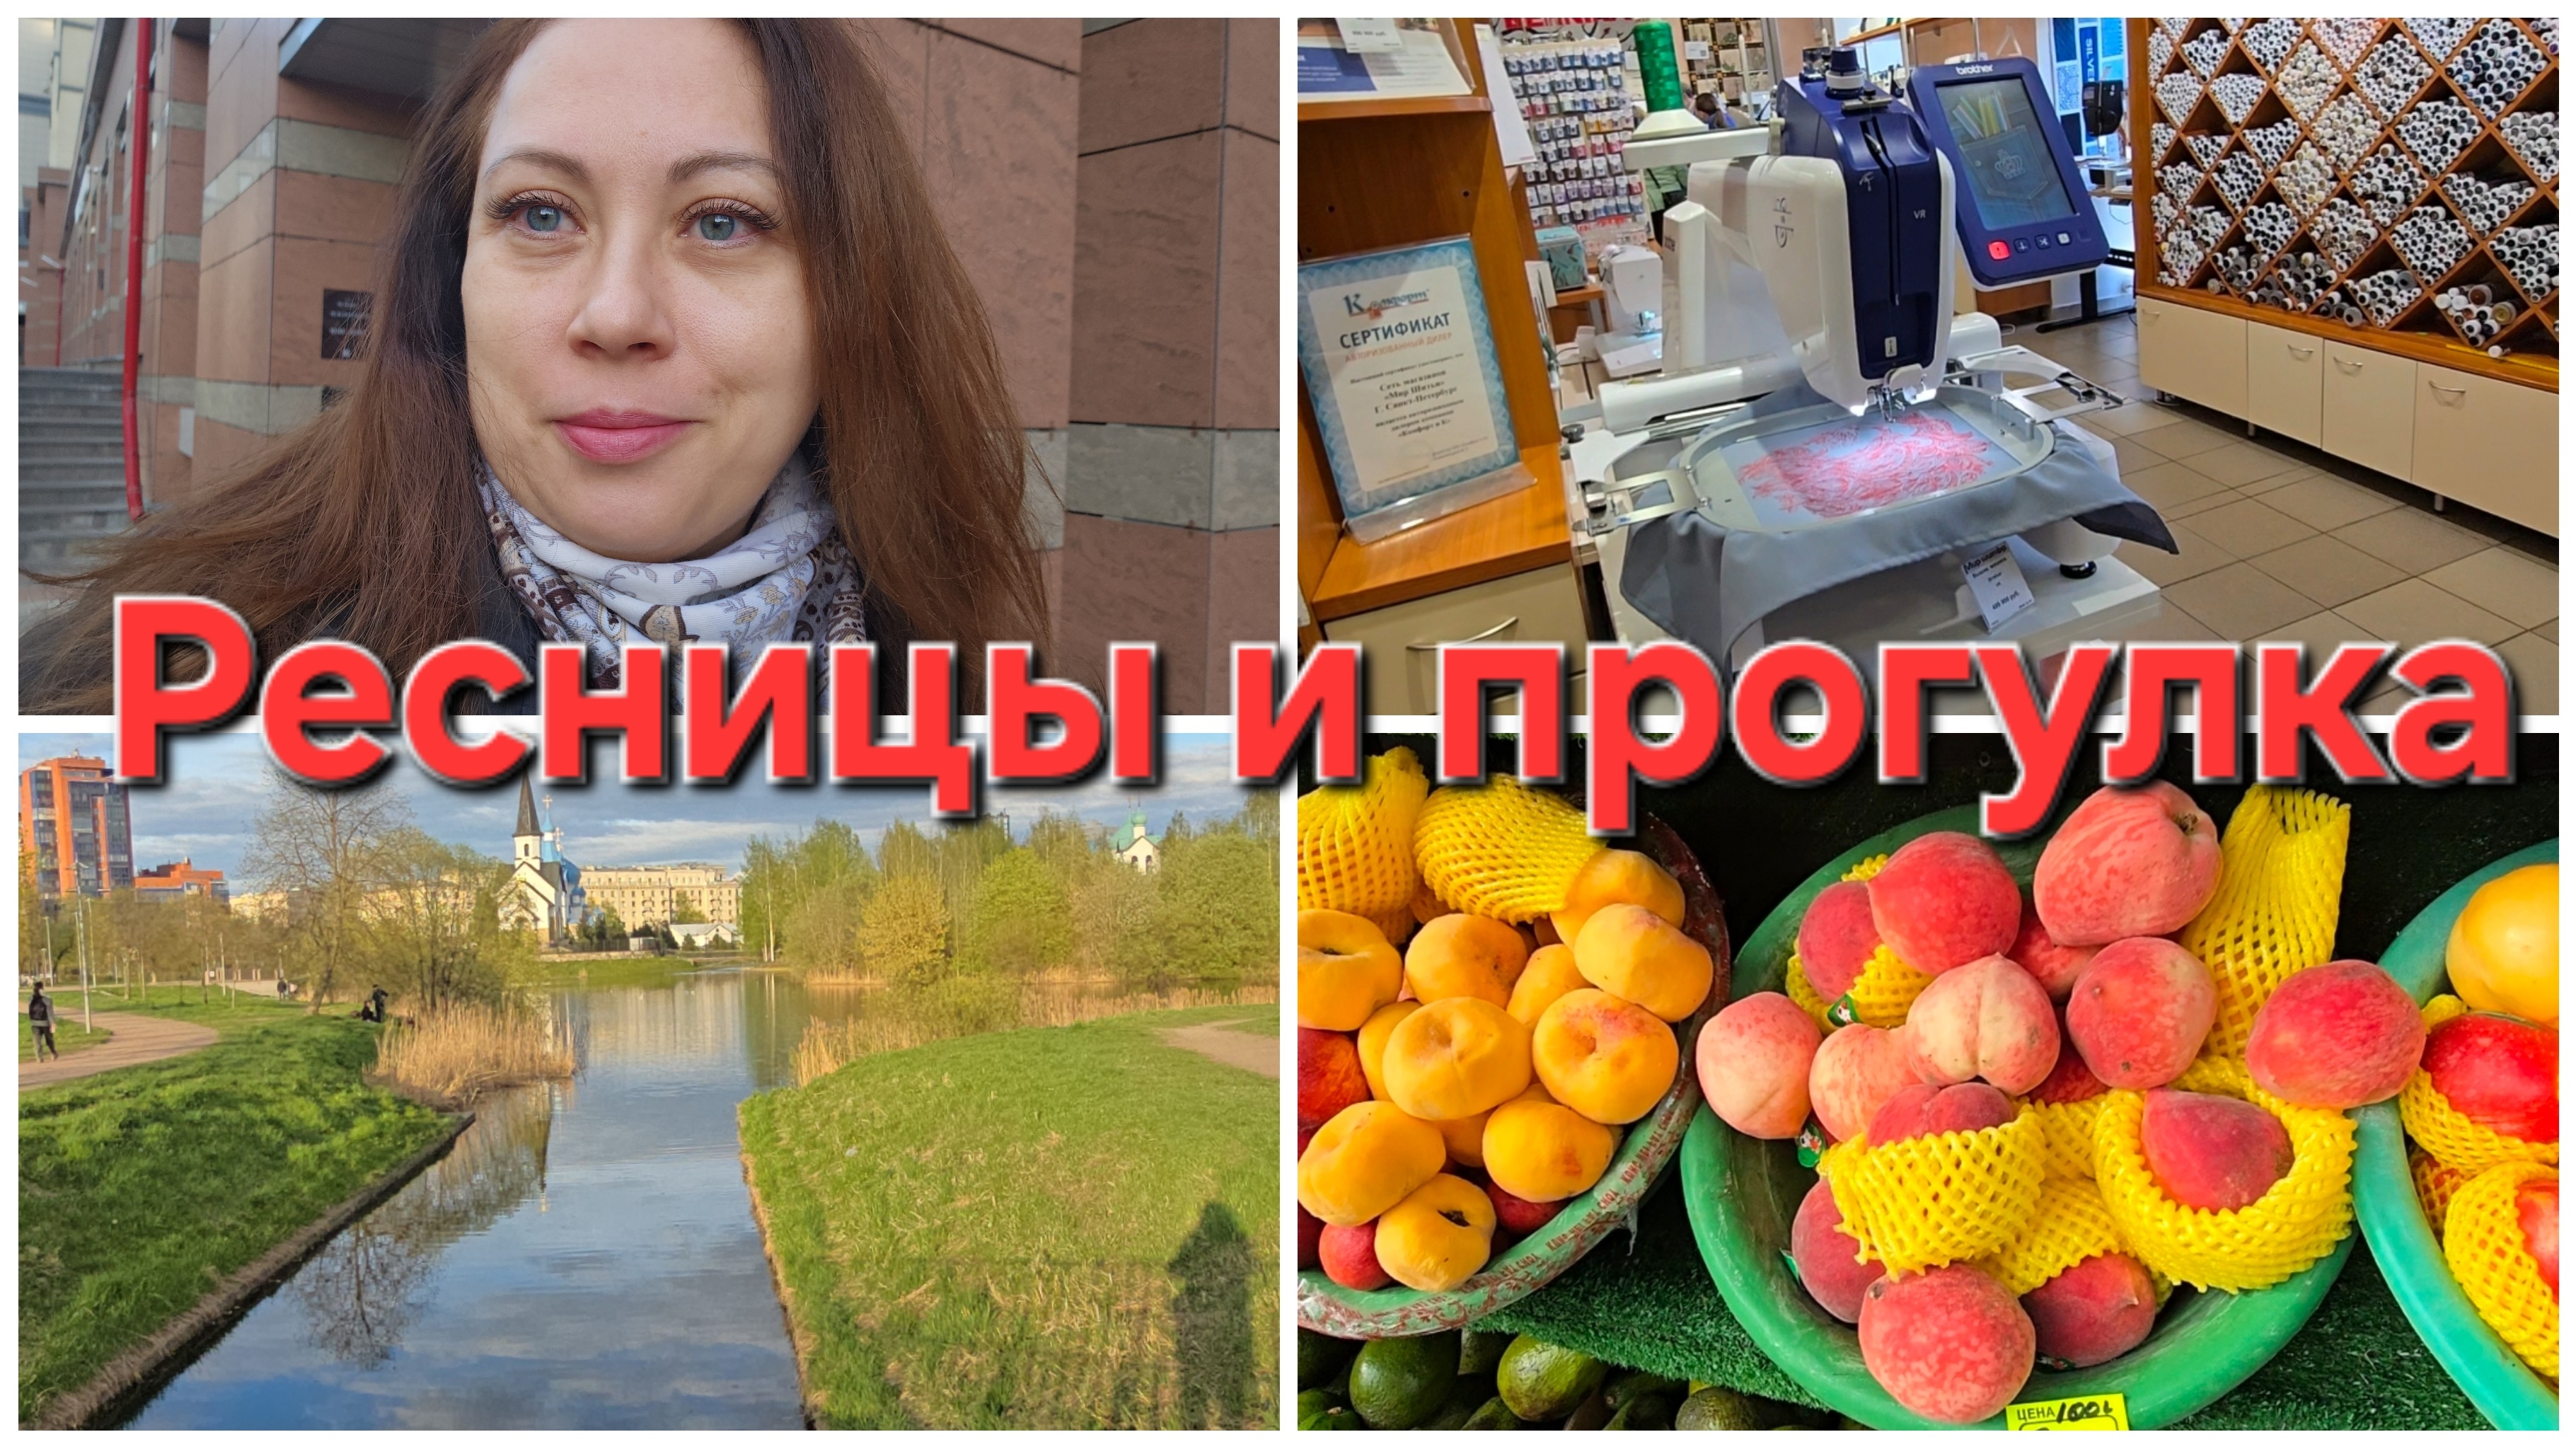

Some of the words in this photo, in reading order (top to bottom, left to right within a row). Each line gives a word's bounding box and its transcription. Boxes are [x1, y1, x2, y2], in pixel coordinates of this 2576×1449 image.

[1956, 64, 1993, 75] brother
[2085, 37, 2096, 82] SILVE
[1914, 209, 1926, 219] VR
[1339, 312, 1450, 349] СЕРТИФИКАТ
[1345, 340, 1424, 362] АВТОРИЗОВАННЫЙ
[1426, 333, 1452, 345] ДИЛЕР
[1380, 382, 1401, 391] Сеть
[1403, 370, 1446, 386] магазинов
[1385, 386, 1457, 410] Санкт-Петербург
[2016, 1407, 2056, 1422] ЦЕНА
